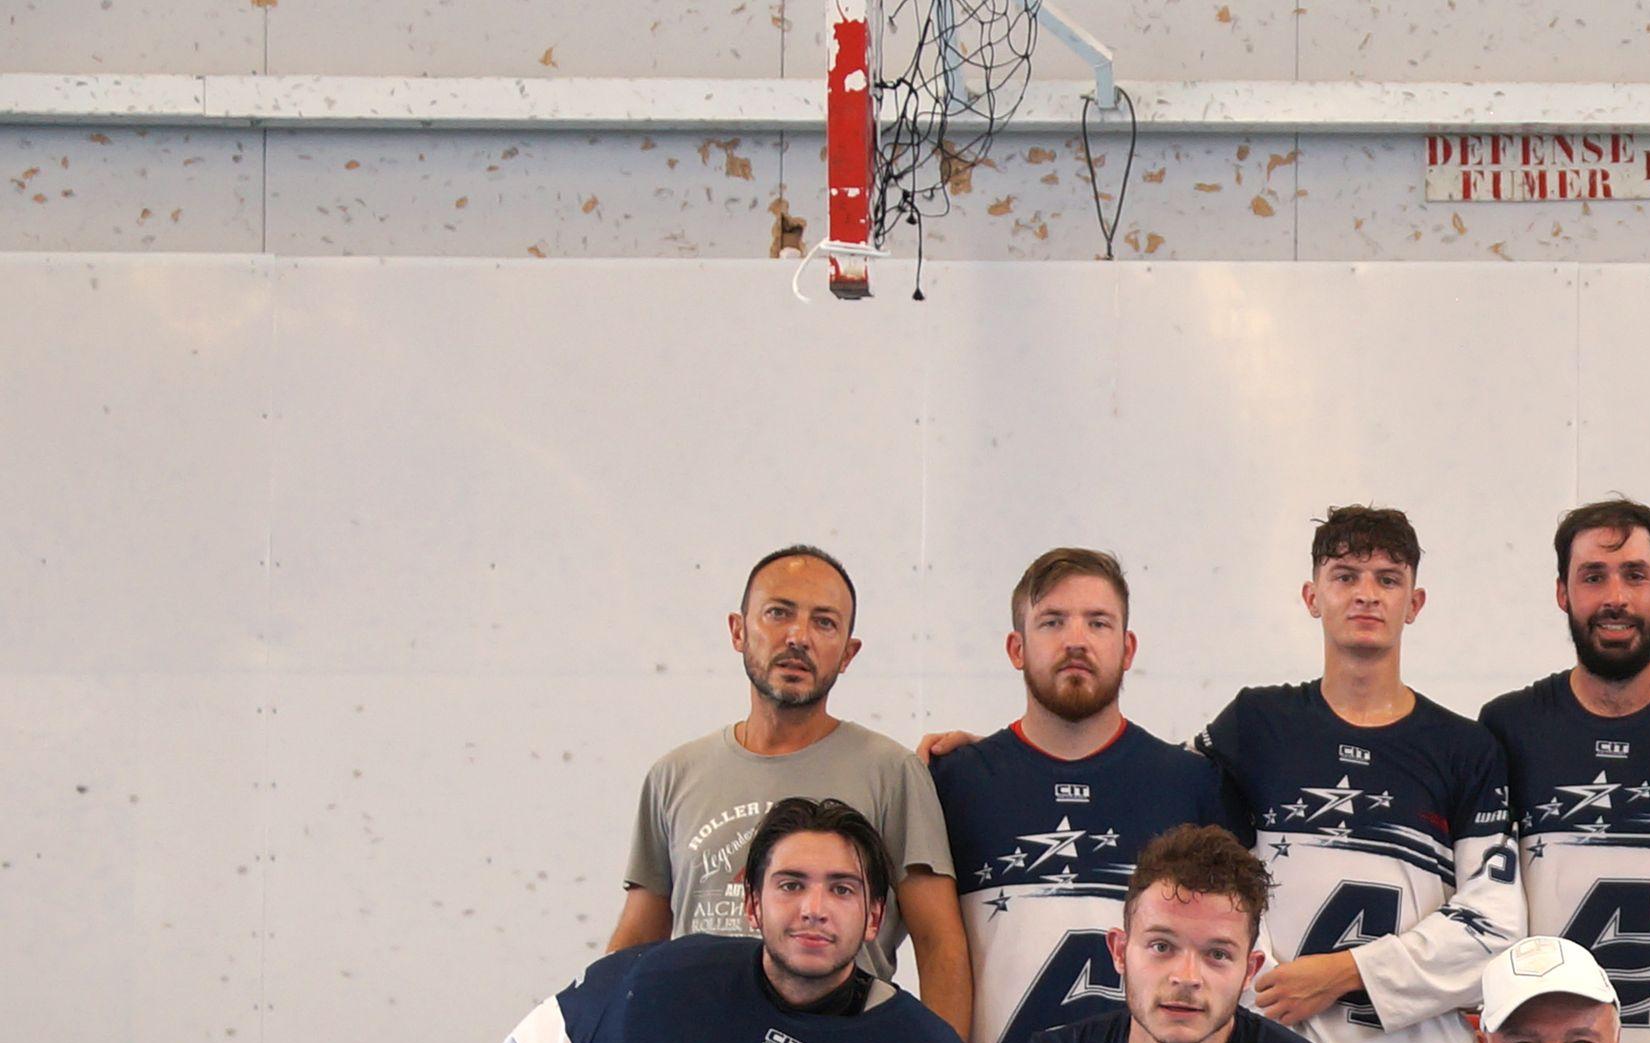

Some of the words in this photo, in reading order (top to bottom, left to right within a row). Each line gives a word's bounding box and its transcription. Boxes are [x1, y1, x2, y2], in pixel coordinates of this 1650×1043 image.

[1426, 132, 1635, 167] DEFENSE
[1461, 169, 1613, 200] FUMER
[688, 801, 761, 851] ROLLER
